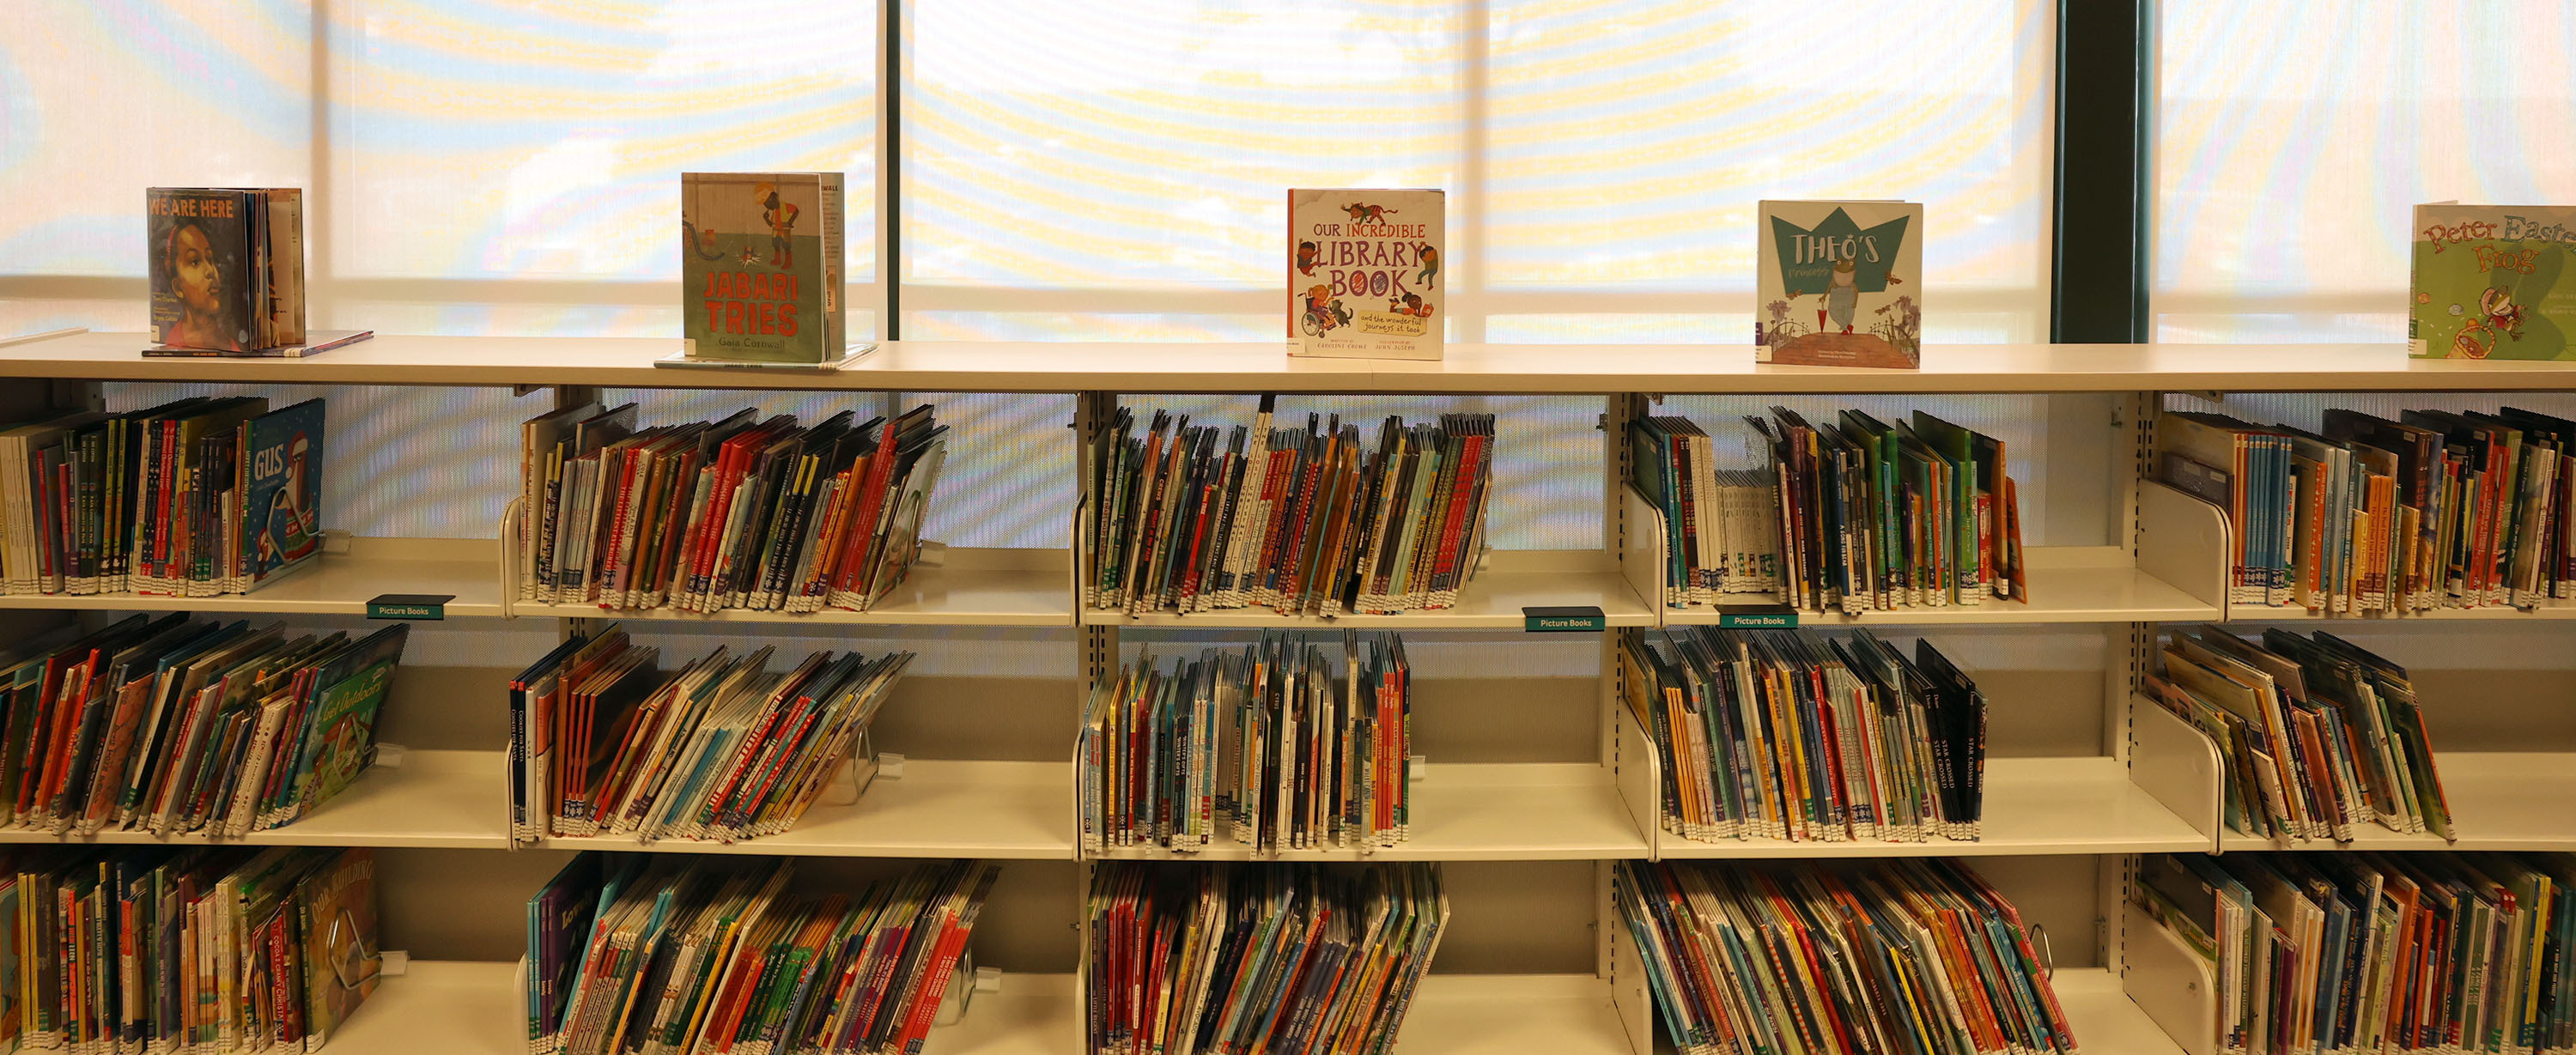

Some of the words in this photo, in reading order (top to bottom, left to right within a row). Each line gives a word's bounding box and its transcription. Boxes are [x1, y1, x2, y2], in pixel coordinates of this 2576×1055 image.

[150, 198, 167, 215] WE
[170, 199, 197, 216] ARE
[200, 199, 234, 218] HERE
[1314, 223, 1340, 236] OUR
[1346, 224, 1425, 238] INCREDIBLE
[2424, 221, 2498, 254] Peter
[1317, 240, 1424, 267] LIBRARY
[1789, 233, 1880, 264] THEO'S
[2472, 244, 2539, 275] Frog
[704, 272, 799, 300] JABARI
[1330, 270, 1408, 296] BOOK
[705, 301, 799, 337] TRIES
[1386, 317, 1422, 325] wonderful
[719, 337, 739, 348] Gaia
[744, 337, 785, 349] Cornwall
[254, 443, 284, 481] GUS
[1479, 442, 1487, 462] CURATO
[1485, 440, 1493, 460] CURATO
[1244, 453, 1254, 477] LOST
[1252, 453, 1261, 477] LOST
[1230, 486, 1246, 541] CHRISTMAS
[1237, 486, 1254, 542] CHRISTMAS
[1364, 518, 1374, 541] SHADOW
[1339, 549, 1347, 570] TRAINING
[323, 701, 340, 722] Get
[340, 680, 384, 715] Outdoors
[762, 708, 773, 721] ONLY
[1936, 758, 1947, 789] CROSSED
[1944, 758, 1954, 788] CROSSED
[312, 888, 331, 925] OUR
[331, 859, 374, 900] BUILDING
[878, 975, 890, 996] Christmas
[945, 968, 953, 979] Fiona
[927, 978, 939, 997] Christmas
[933, 978, 944, 997] Christmas
[938, 979, 948, 998] Christmas
[1766, 1014, 1777, 1034] PANDA
